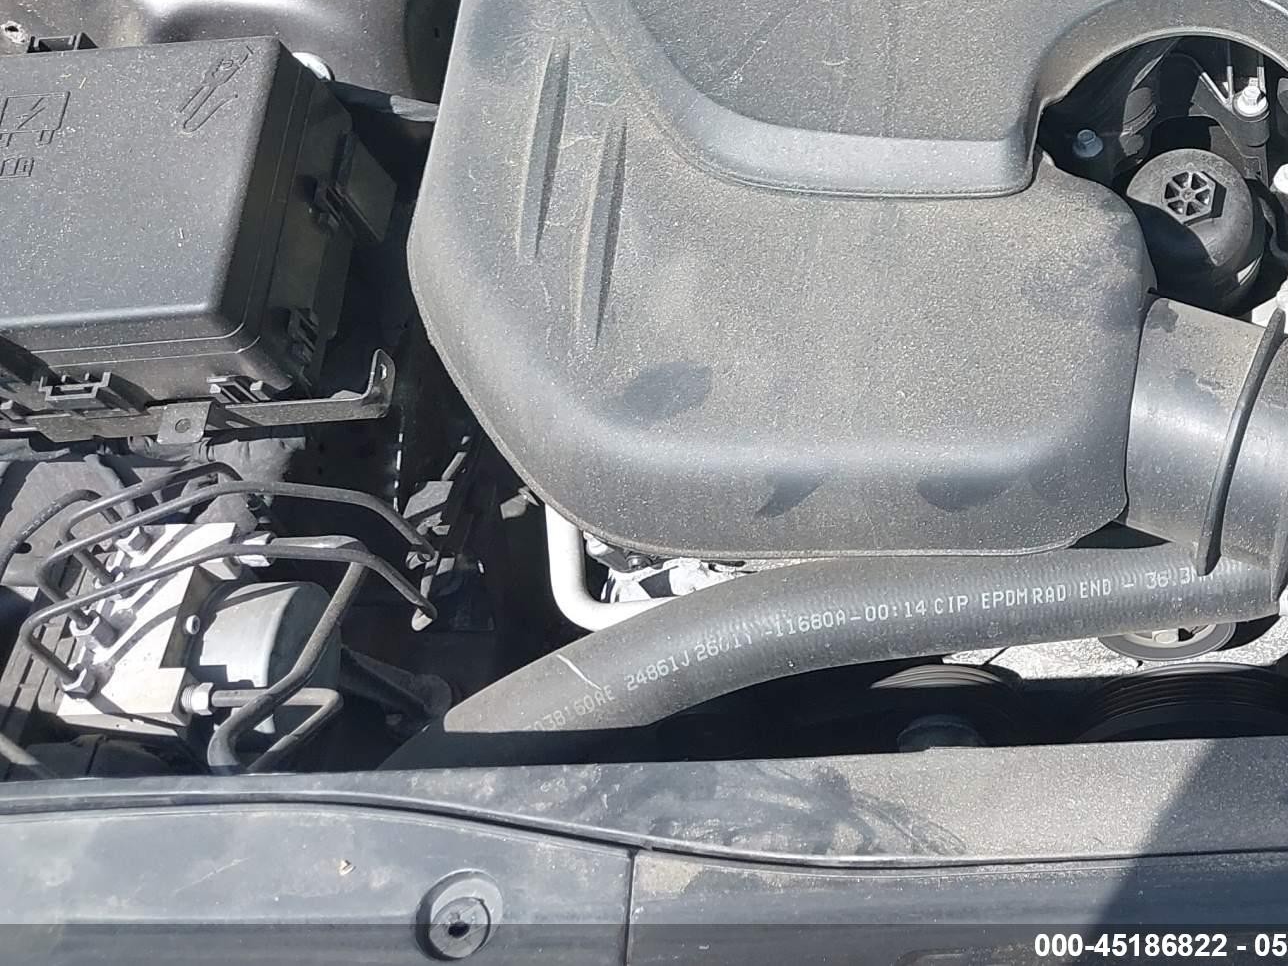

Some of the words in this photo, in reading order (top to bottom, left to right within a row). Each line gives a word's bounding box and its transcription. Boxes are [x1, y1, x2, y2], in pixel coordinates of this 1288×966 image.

[625, 650, 690, 690] 24861J
[933, 594, 969, 615] CIP
[980, 587, 1028, 610] EPDM
[1031, 583, 1067, 605] RAD
[1079, 578, 1112, 598] END
